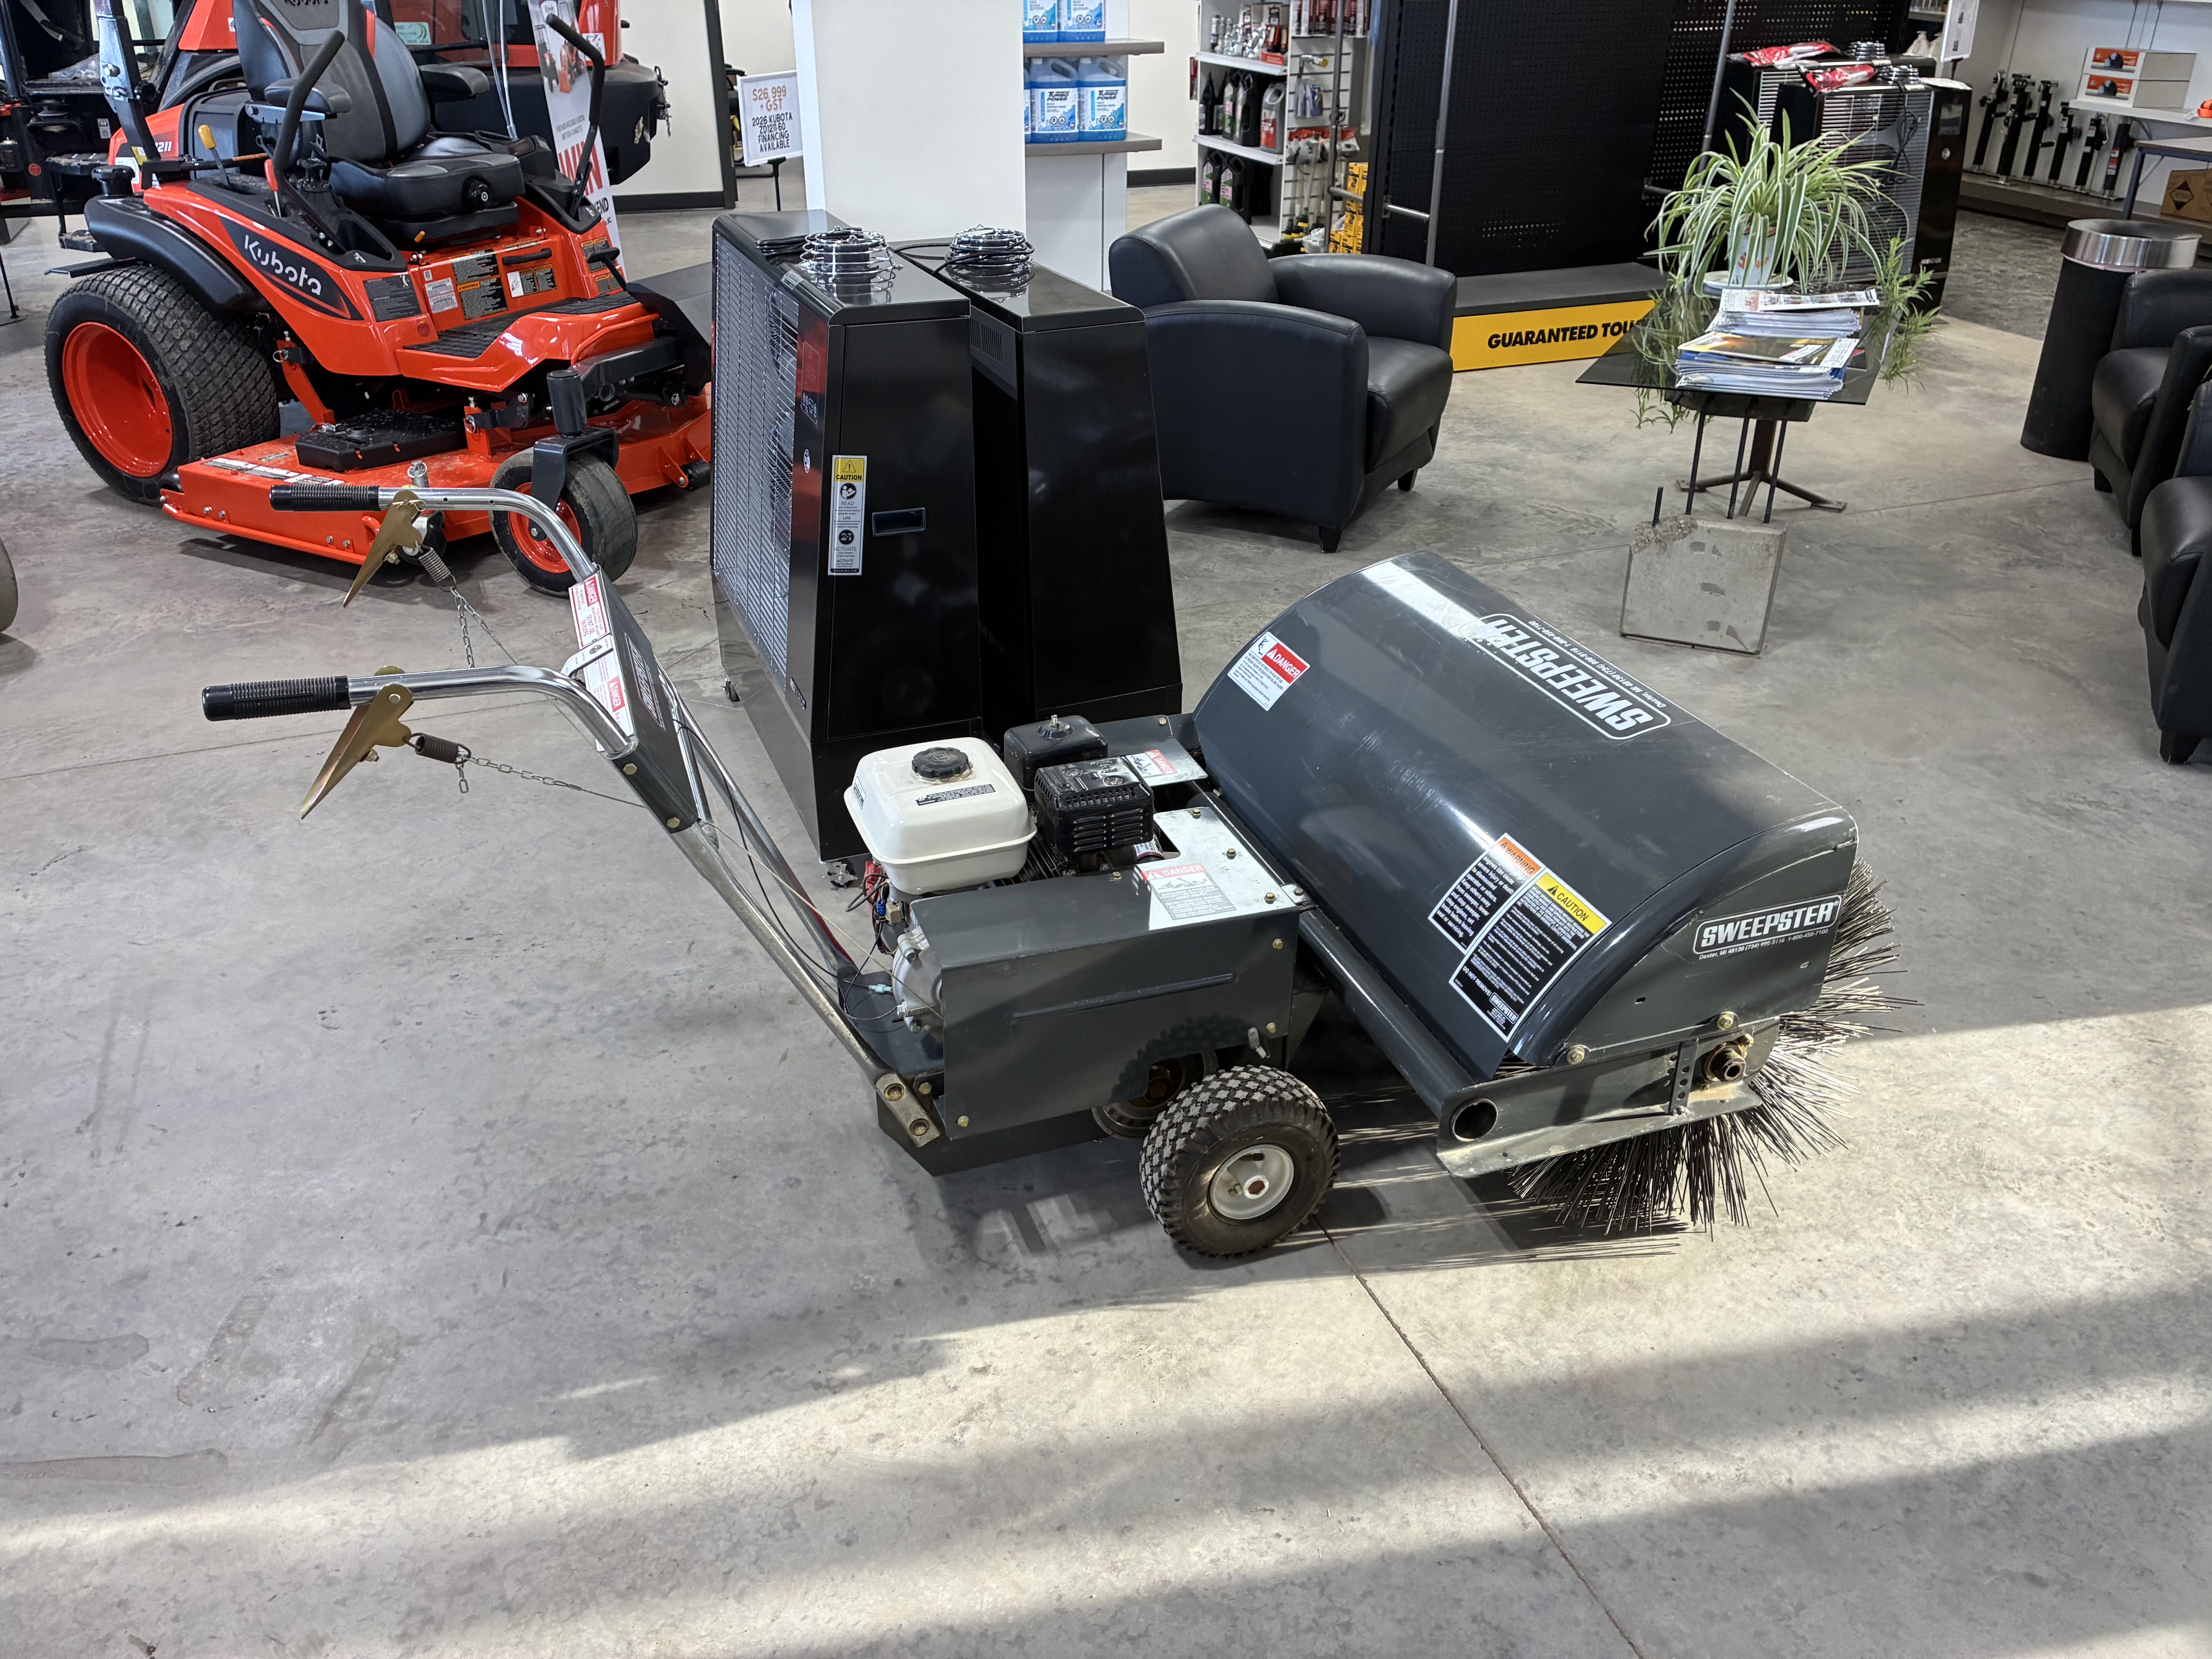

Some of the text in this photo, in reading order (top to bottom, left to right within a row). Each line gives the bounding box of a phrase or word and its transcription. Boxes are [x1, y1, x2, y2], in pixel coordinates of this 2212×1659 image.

[752, 85, 787, 101] $26,999
[766, 98, 783, 112] GST
[752, 112, 793, 126] 2026 KUBOTA
[758, 130, 789, 144] FINANCING
[760, 139, 790, 153] AVAILABLE
[245, 235, 321, 295] Kubota
[1488, 325, 1598, 349] GUARANTEED
[586, 584, 598, 605] DANGER
[1272, 653, 1301, 679] DANGER
[1475, 619, 1653, 730] SWEEPSTER
[1610, 672, 1635, 688] 48130
[610, 687, 622, 708] DANGER
[1629, 685, 1644, 694] MI
[1639, 691, 1668, 709] Dexter,
[1153, 757, 1175, 774] DANGER
[1161, 865, 1204, 876] DANGER
[1481, 855, 1515, 884] engines can cause
[1503, 847, 1535, 875] WARNING
[1465, 872, 1482, 889] operator
[1484, 888, 1499, 903] others.
[1475, 869, 1498, 890] dismounted
[1477, 861, 1490, 874] severe
[1487, 870, 1501, 883] injury
[1502, 883, 1515, 895] death
[1450, 890, 1481, 921] and stop sweeper,
[1455, 884, 1490, 917] from sweeper, lower
[1460, 878, 1491, 908] Keep others away
[1555, 891, 1589, 922] CAUTION
[1436, 909, 1446, 918] seat
[1446, 919, 1466, 938] servicing.
[1440, 902, 1475, 937] brake before leaving
[1444, 896, 1456, 907] stop
[1466, 916, 1475, 924] set
[1701, 901, 1834, 947] SWEEPSTER
[1698, 951, 1719, 961] Dexter,
[1728, 946, 1744, 954] 48130
[1745, 942, 1760, 951] (734)
[1788, 927, 1828, 942] 1-800-456-7100
[1462, 965, 1492, 997] DO NOT REMOVE!
[1490, 994, 1517, 1022] SWEEPSTER
